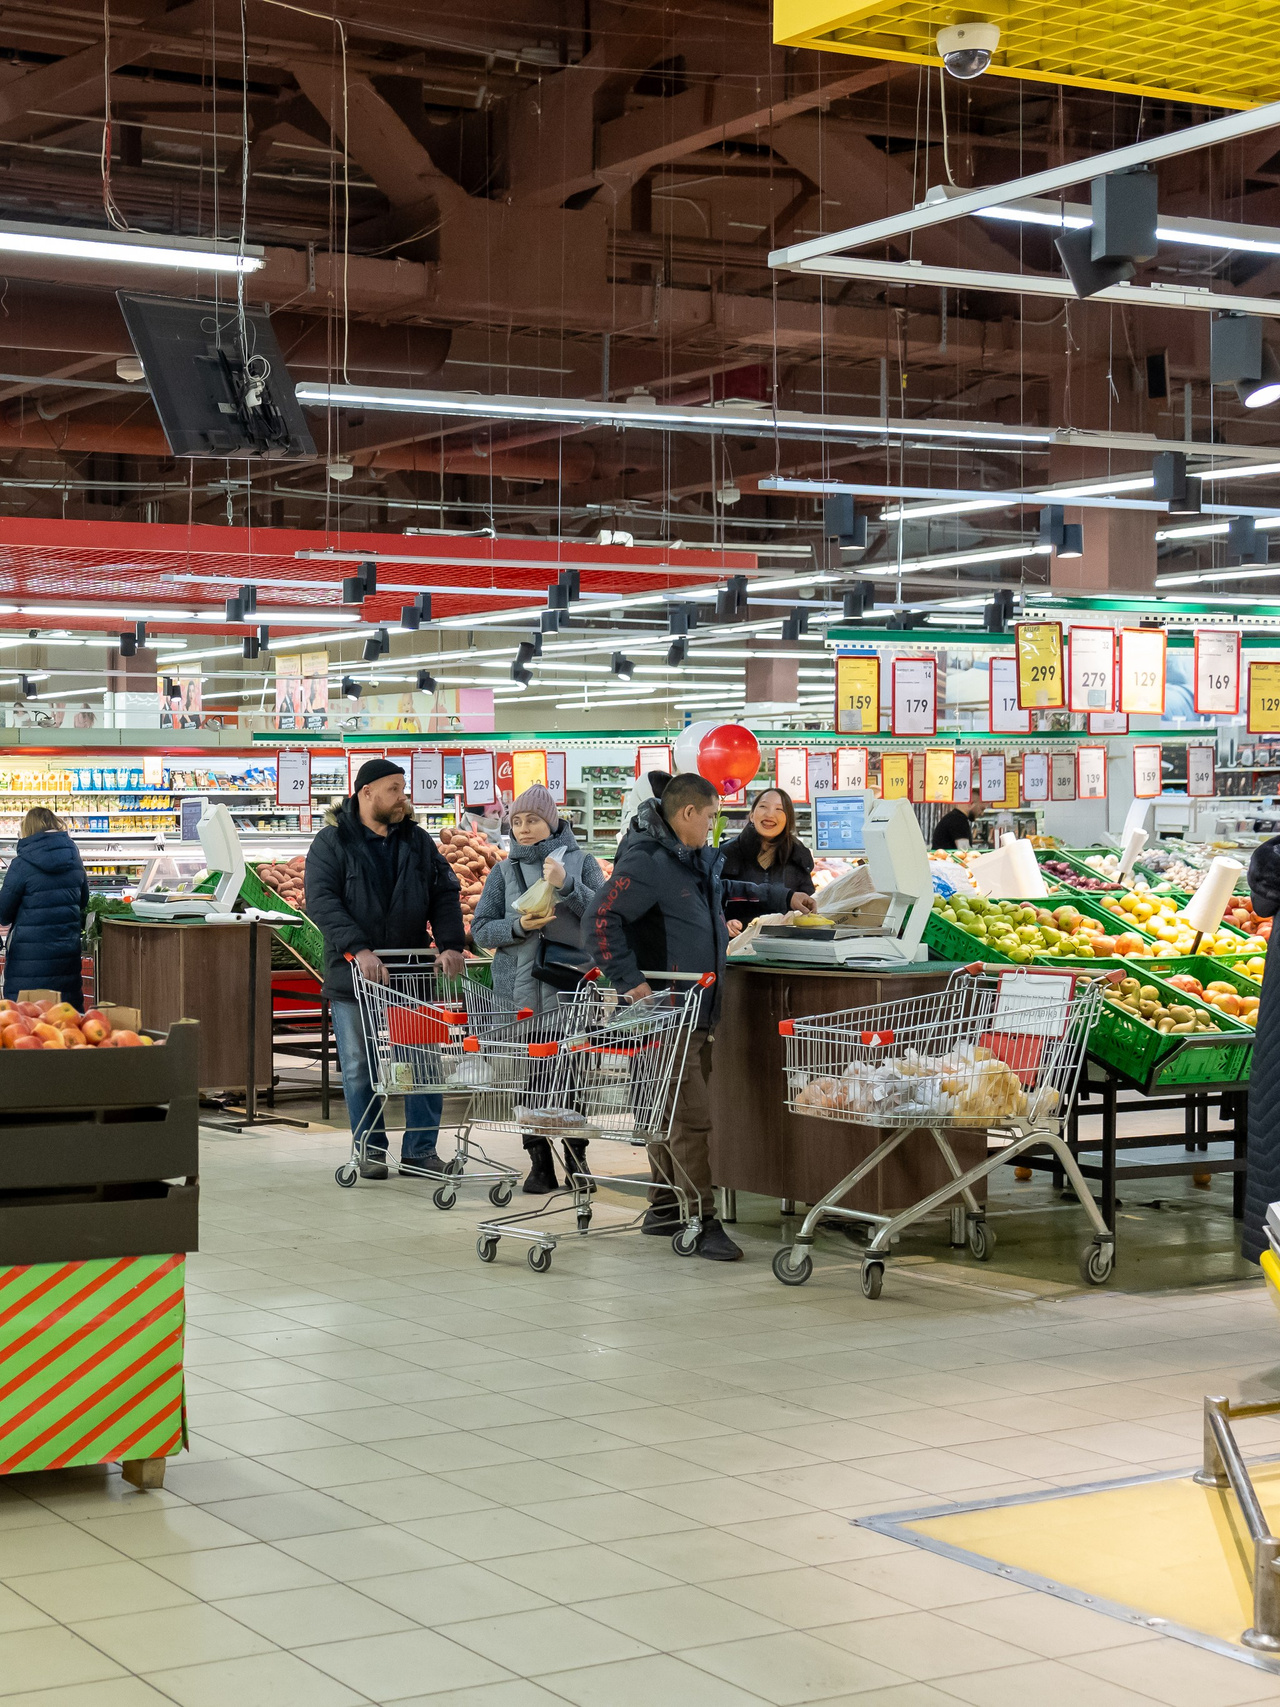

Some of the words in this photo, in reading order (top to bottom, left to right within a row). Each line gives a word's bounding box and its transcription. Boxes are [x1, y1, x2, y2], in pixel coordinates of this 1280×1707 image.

[1031, 665, 1056, 682] 299
[1133, 671, 1157, 687] 129
[1082, 672, 1106, 687] 279
[1208, 674, 1230, 689] 169
[848, 695, 872, 710] 159
[906, 699, 928, 713] 179
[1261, 698, 1280, 711] 129
[790, 776, 802, 786] 45
[846, 776, 862, 786] 149
[890, 777, 905, 787] 199
[938, 775, 950, 785] 29
[1057, 777, 1072, 787] 389
[1086, 773, 1101, 784] 139
[1142, 771, 1157, 782] 159
[1194, 772, 1210, 782] 349
[292, 779, 305, 790] 29
[421, 779, 438, 790] 109
[473, 779, 490, 791] 229
[548, 780, 561, 790] 59
[814, 779, 830, 789] 459
[954, 780, 967, 790] 269
[987, 779, 1002, 789] 299
[1030, 778, 1044, 787] 339
